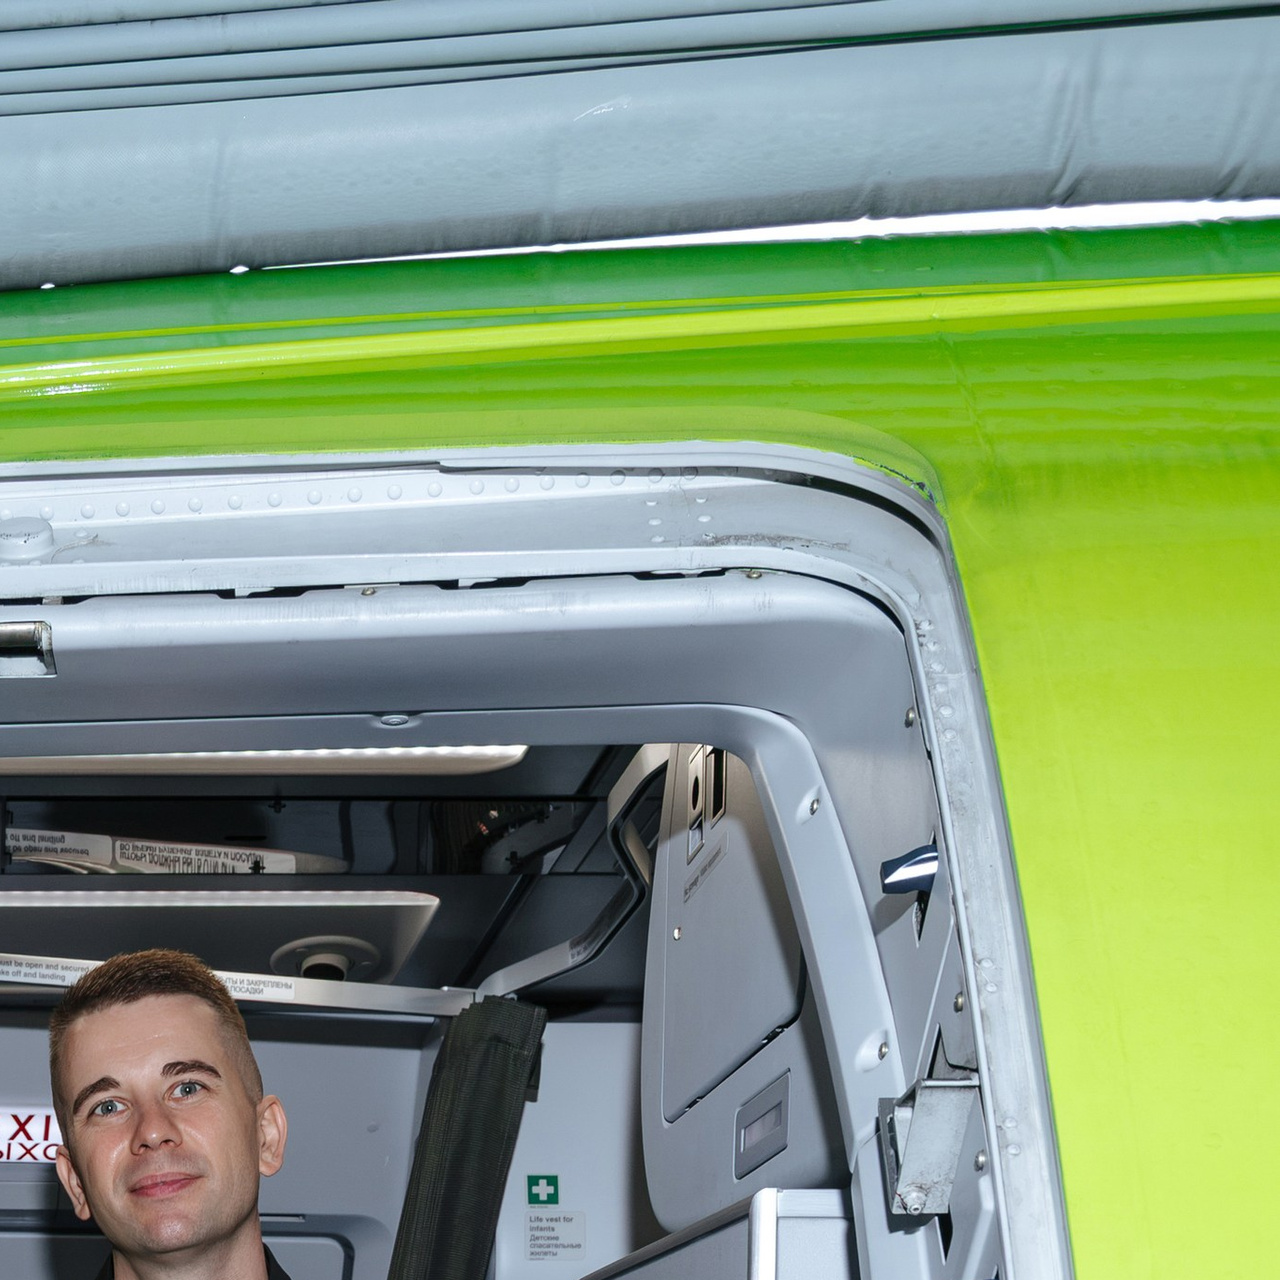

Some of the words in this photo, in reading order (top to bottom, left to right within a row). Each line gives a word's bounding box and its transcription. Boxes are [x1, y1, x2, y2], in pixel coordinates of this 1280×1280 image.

[14, 960, 23, 968] be
[25, 961, 43, 971] open
[45, 962, 59, 971] and
[61, 963, 90, 973] secured
[12, 970, 22, 978] off
[23, 971, 37, 979] and
[39, 973, 66, 982] landing
[230, 985, 265, 995] ПОСАДКИ
[529, 1234, 560, 1242] Детские
